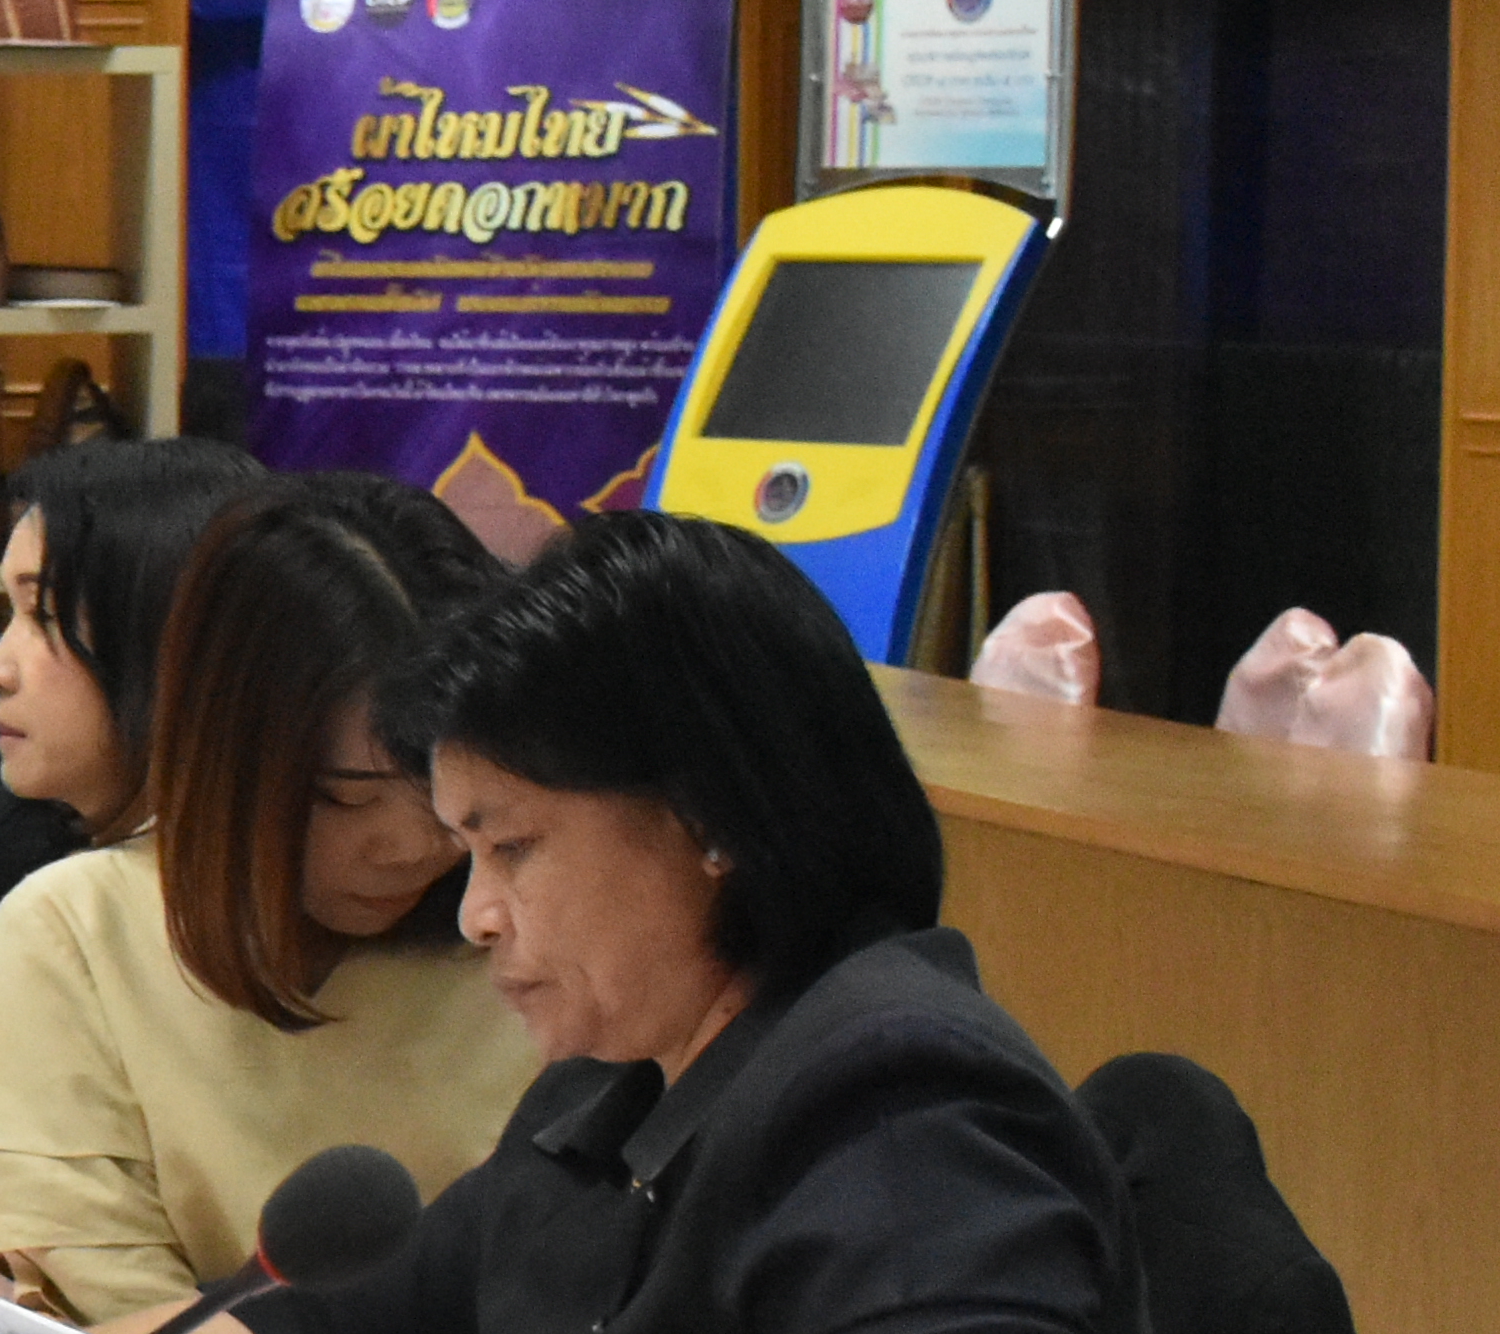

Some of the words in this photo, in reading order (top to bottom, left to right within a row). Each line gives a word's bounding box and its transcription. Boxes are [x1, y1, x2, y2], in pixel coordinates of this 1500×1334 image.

[351, 75, 627, 160] ผ้าไหมไทย
[272, 167, 690, 245] สร้อยดอกหมาก
